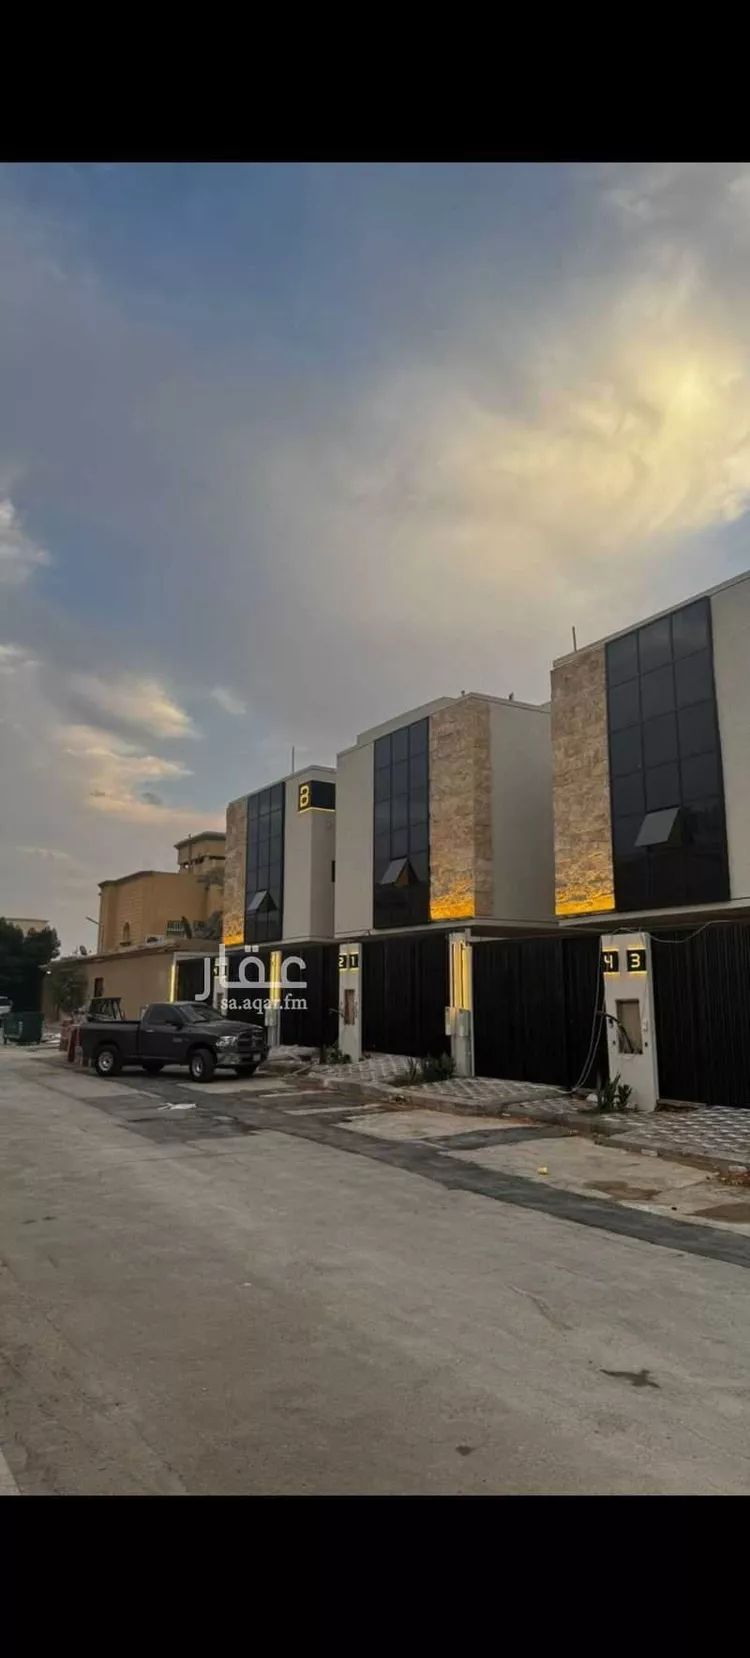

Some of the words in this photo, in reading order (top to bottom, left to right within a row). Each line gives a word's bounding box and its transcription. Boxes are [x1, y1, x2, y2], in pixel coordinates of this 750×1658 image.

[338, 956, 345, 968] 2
[603, 954, 613, 969] 4
[630, 953, 641, 968] 3
